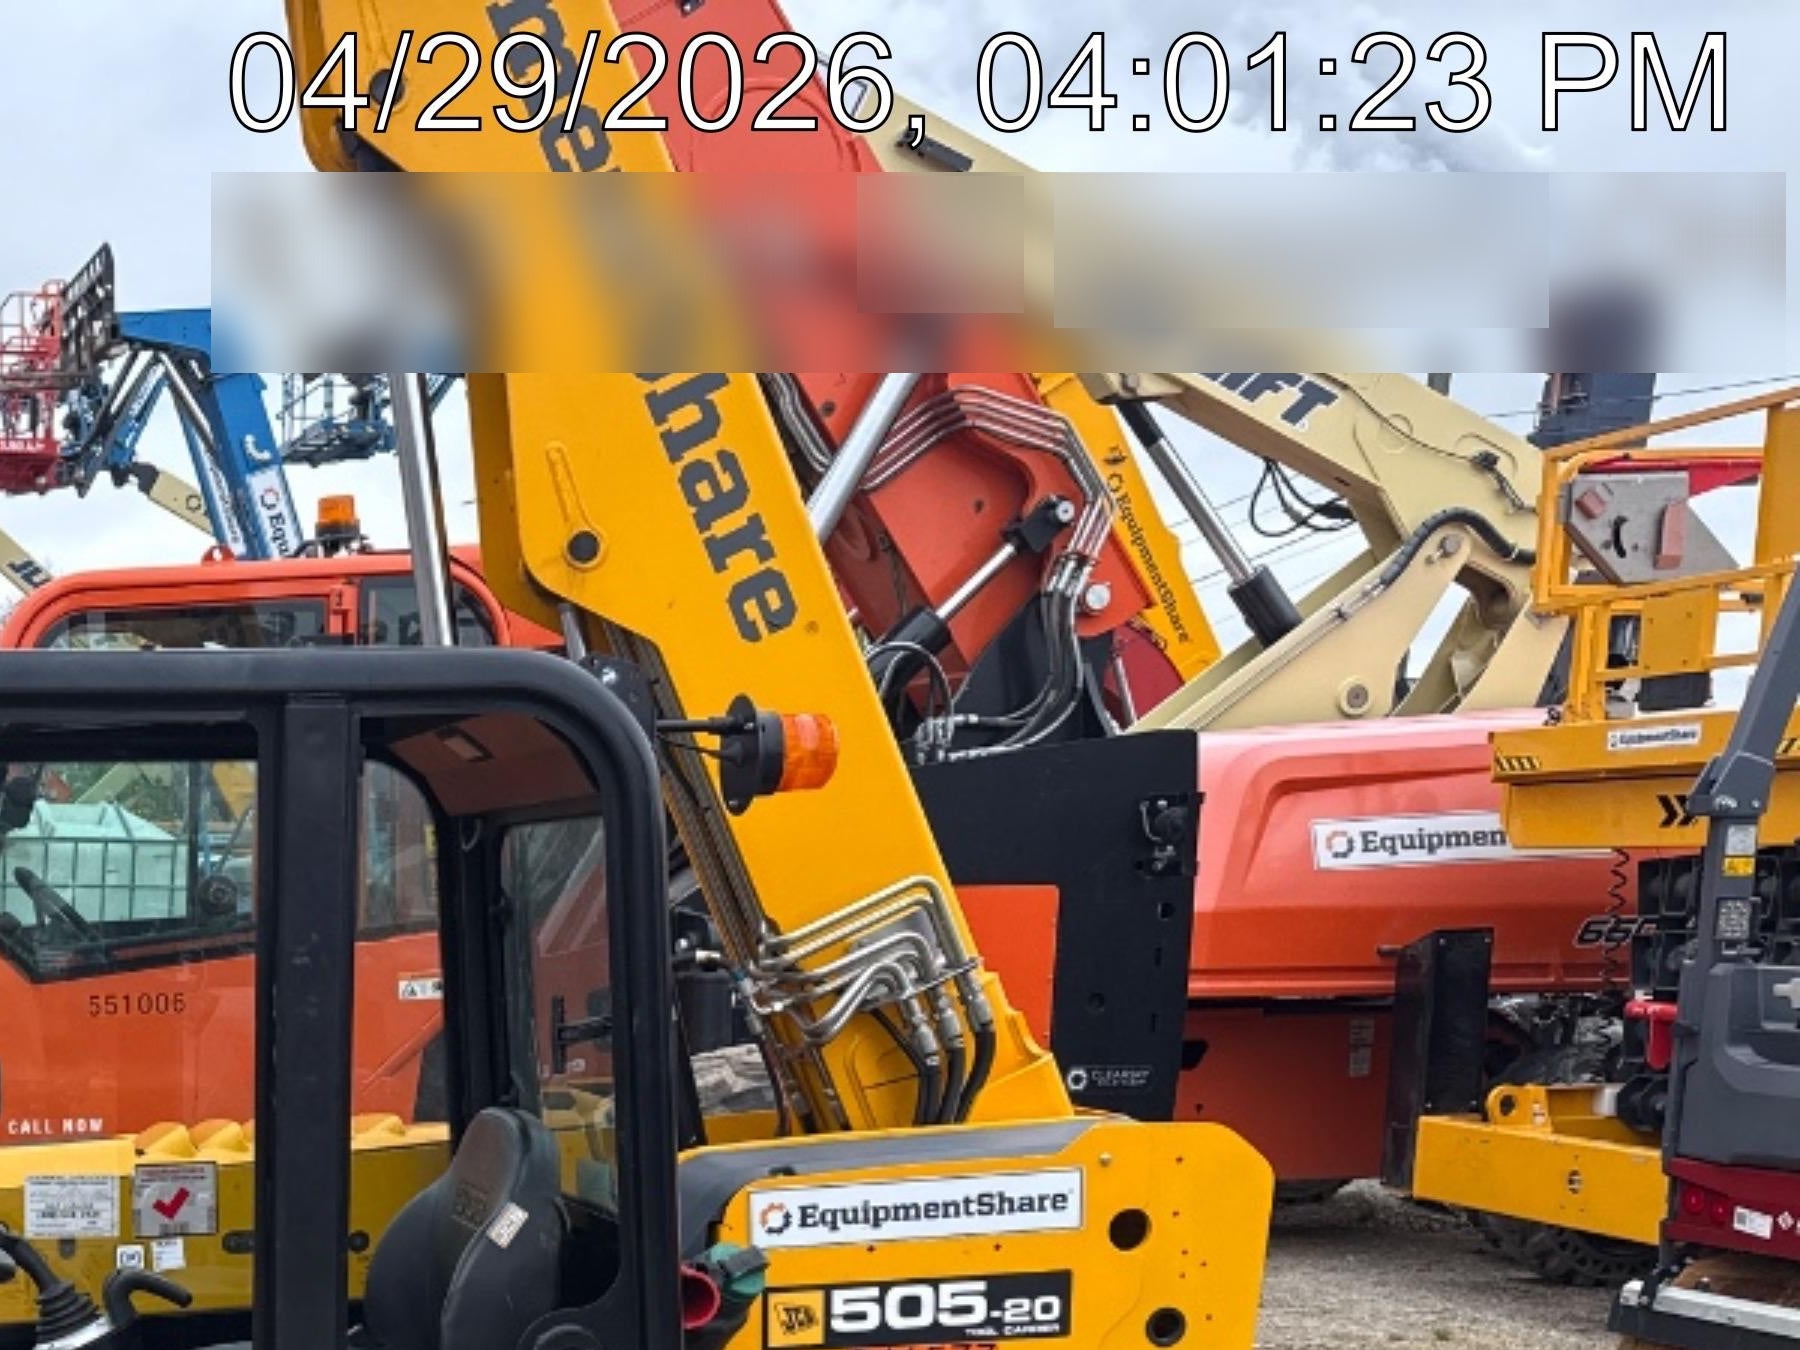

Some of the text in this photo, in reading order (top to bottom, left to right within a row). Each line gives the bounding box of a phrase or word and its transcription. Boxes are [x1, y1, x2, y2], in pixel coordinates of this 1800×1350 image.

[1114, 494, 1189, 643] EquipmentShare
[7, 1117, 104, 1136] CALL NOW
[798, 1189, 1069, 1232] EquipmentShare
[829, 1279, 1061, 1334] 505-20
